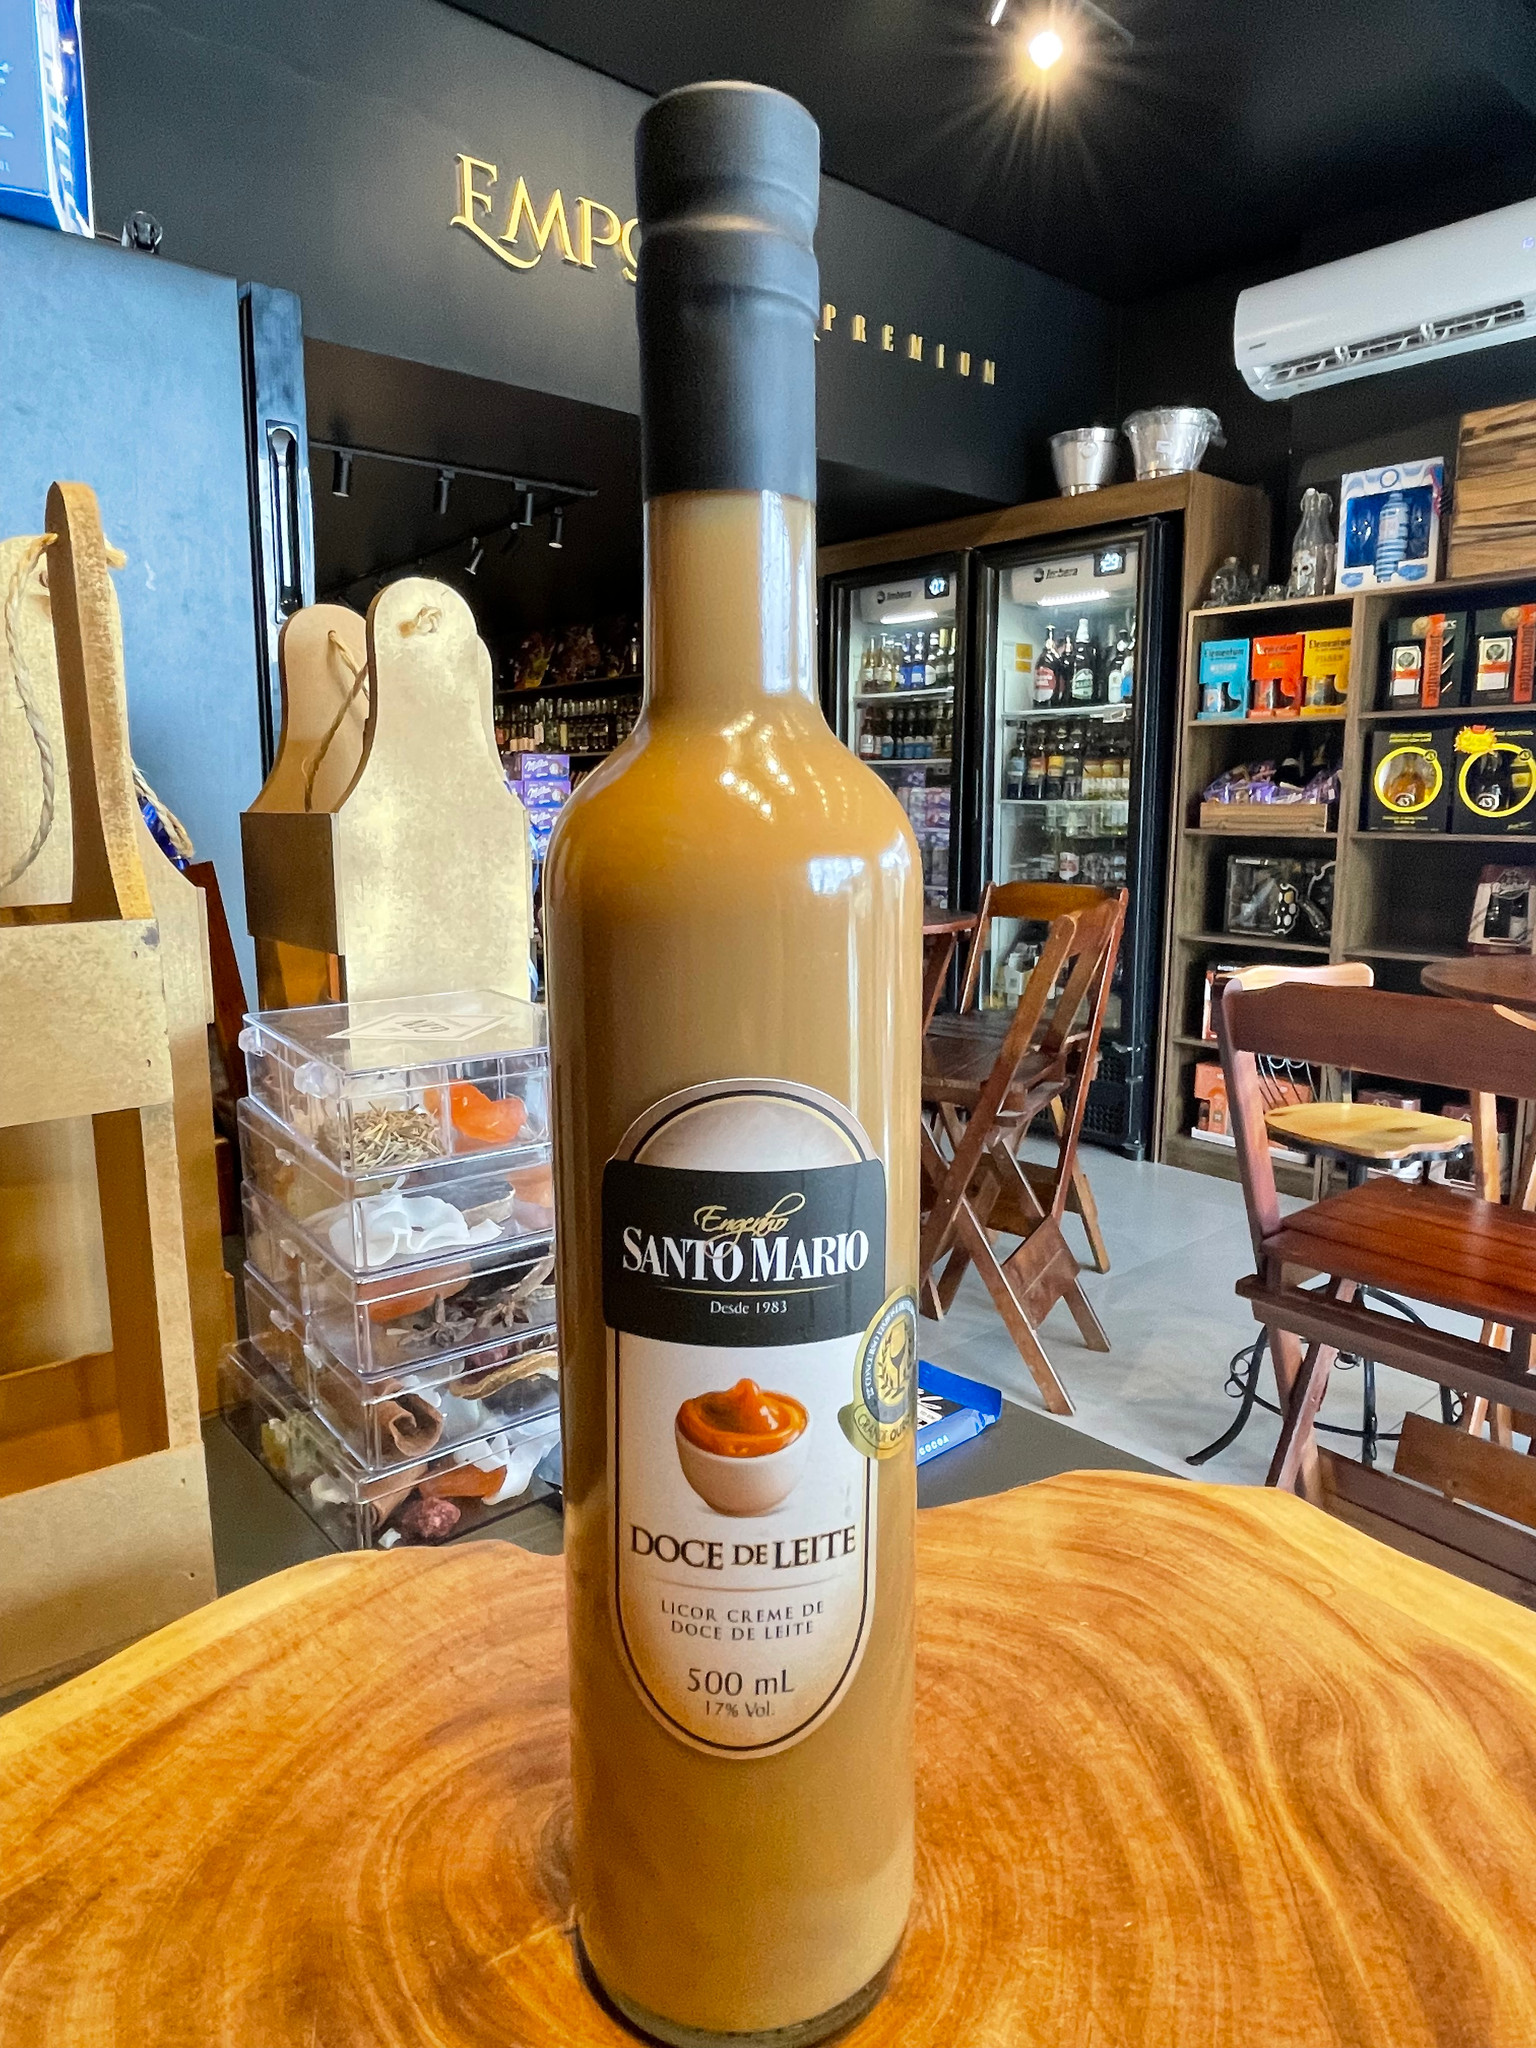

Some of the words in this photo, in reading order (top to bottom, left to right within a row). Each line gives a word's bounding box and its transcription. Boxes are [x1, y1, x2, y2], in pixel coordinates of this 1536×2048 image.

[822, 303, 996, 386] PREMIUM
[694, 1192, 806, 1260] Engenho
[623, 1226, 744, 1283] SANTO
[750, 1230, 869, 1283] MARIO
[710, 1300, 749, 1314] Desde
[755, 1300, 787, 1314] 1983
[918, 1434, 950, 1456] COCOA
[630, 1525, 724, 1570] DOCE
[731, 1544, 768, 1566] DE
[772, 1525, 857, 1570] LEITE
[661, 1600, 716, 1622] LICOR
[727, 1607, 793, 1623] CREME
[802, 1600, 824, 1617] DE
[671, 1620, 722, 1641] DOCE
[732, 1627, 755, 1641] DE
[765, 1620, 814, 1640] LEITE
[687, 1668, 743, 1696] 500
[755, 1669, 795, 1695] mL
[706, 1700, 738, 1718] 17%
[745, 1701, 775, 1718] Vol.
